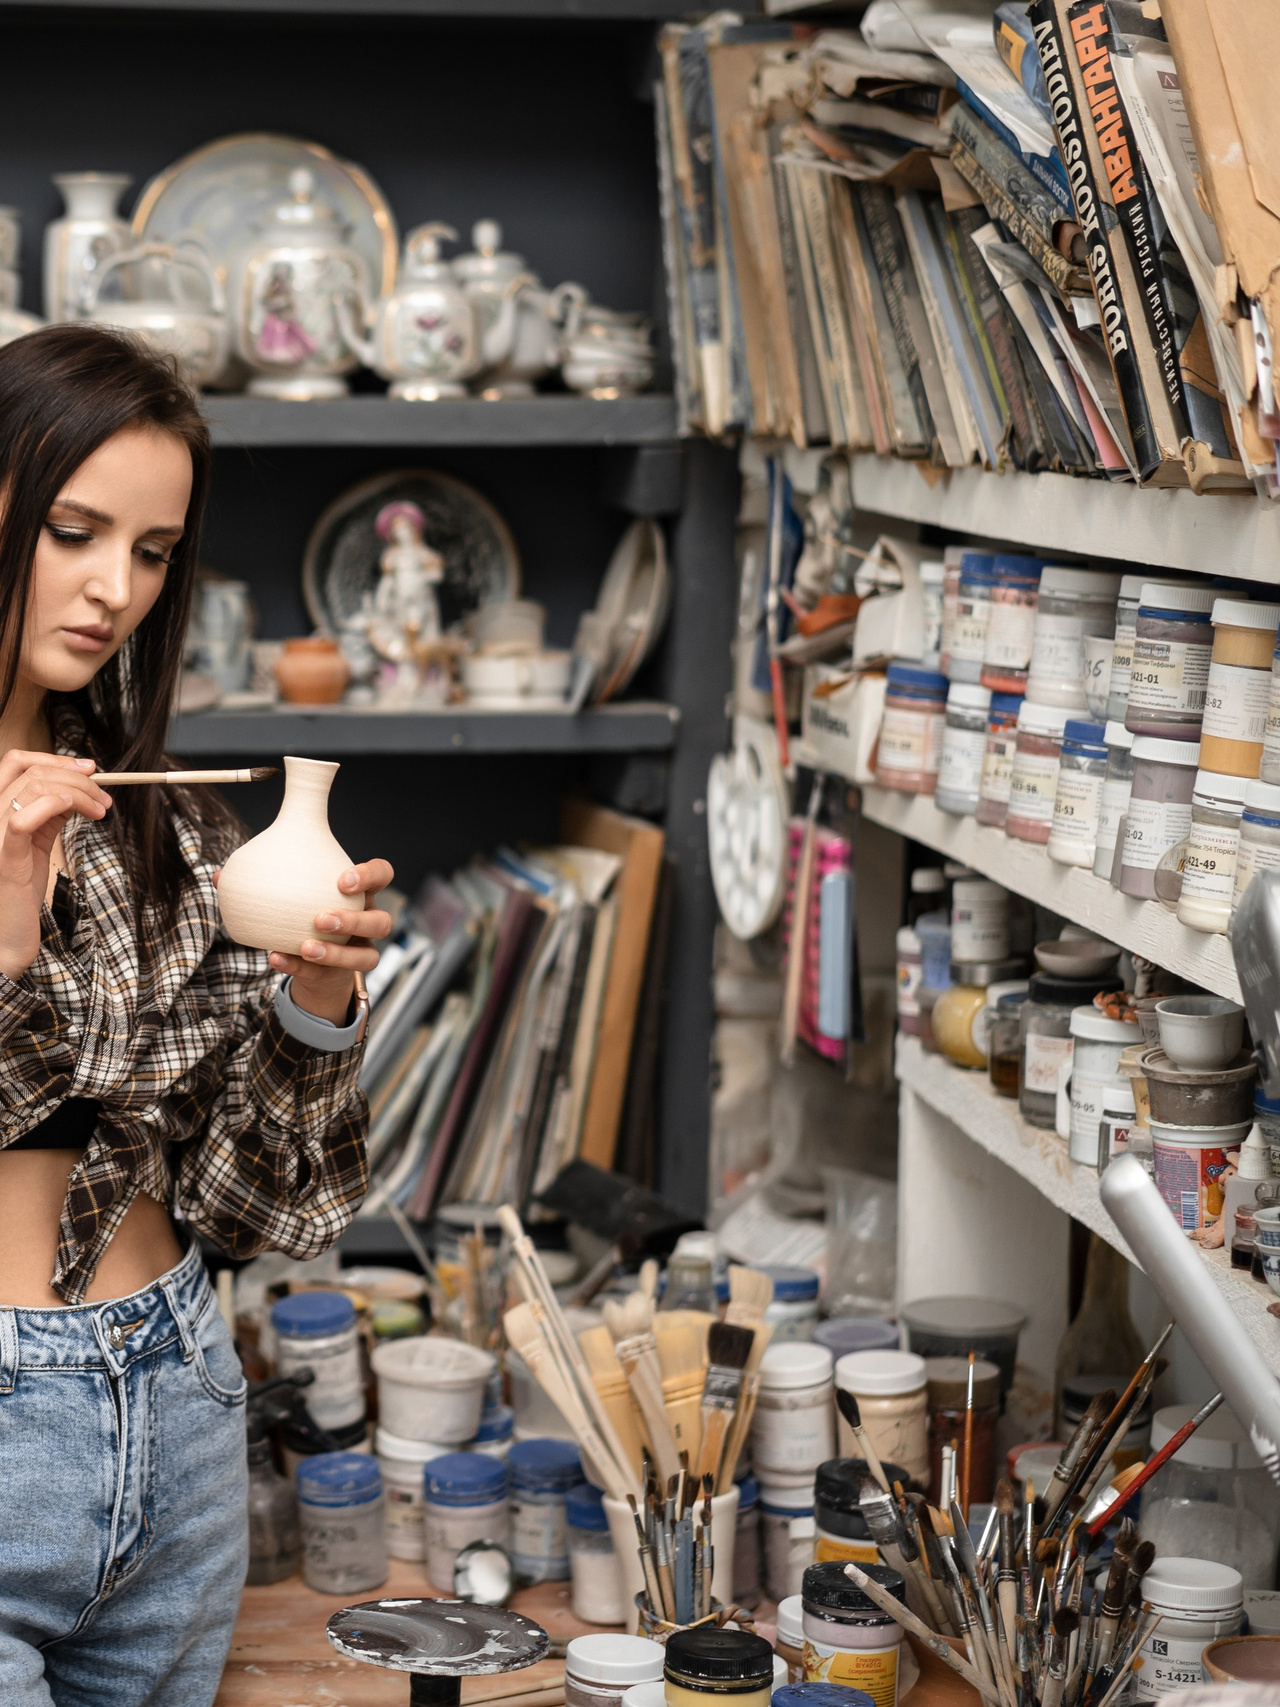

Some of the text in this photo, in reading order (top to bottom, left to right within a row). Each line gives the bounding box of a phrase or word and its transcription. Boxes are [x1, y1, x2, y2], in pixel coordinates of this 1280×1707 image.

[1070, 3, 1138, 204] АВАНГАРД
[1034, 20, 1128, 357] BORIS KOUSTODIEV
[1128, 202, 1154, 278] РУССКИЙ
[1146, 282, 1181, 404] НЕИЗВЕСТНЫЙ
[1150, 1653, 1175, 1664] Terracolor
[1155, 1670, 1202, 1683] S-1421-
